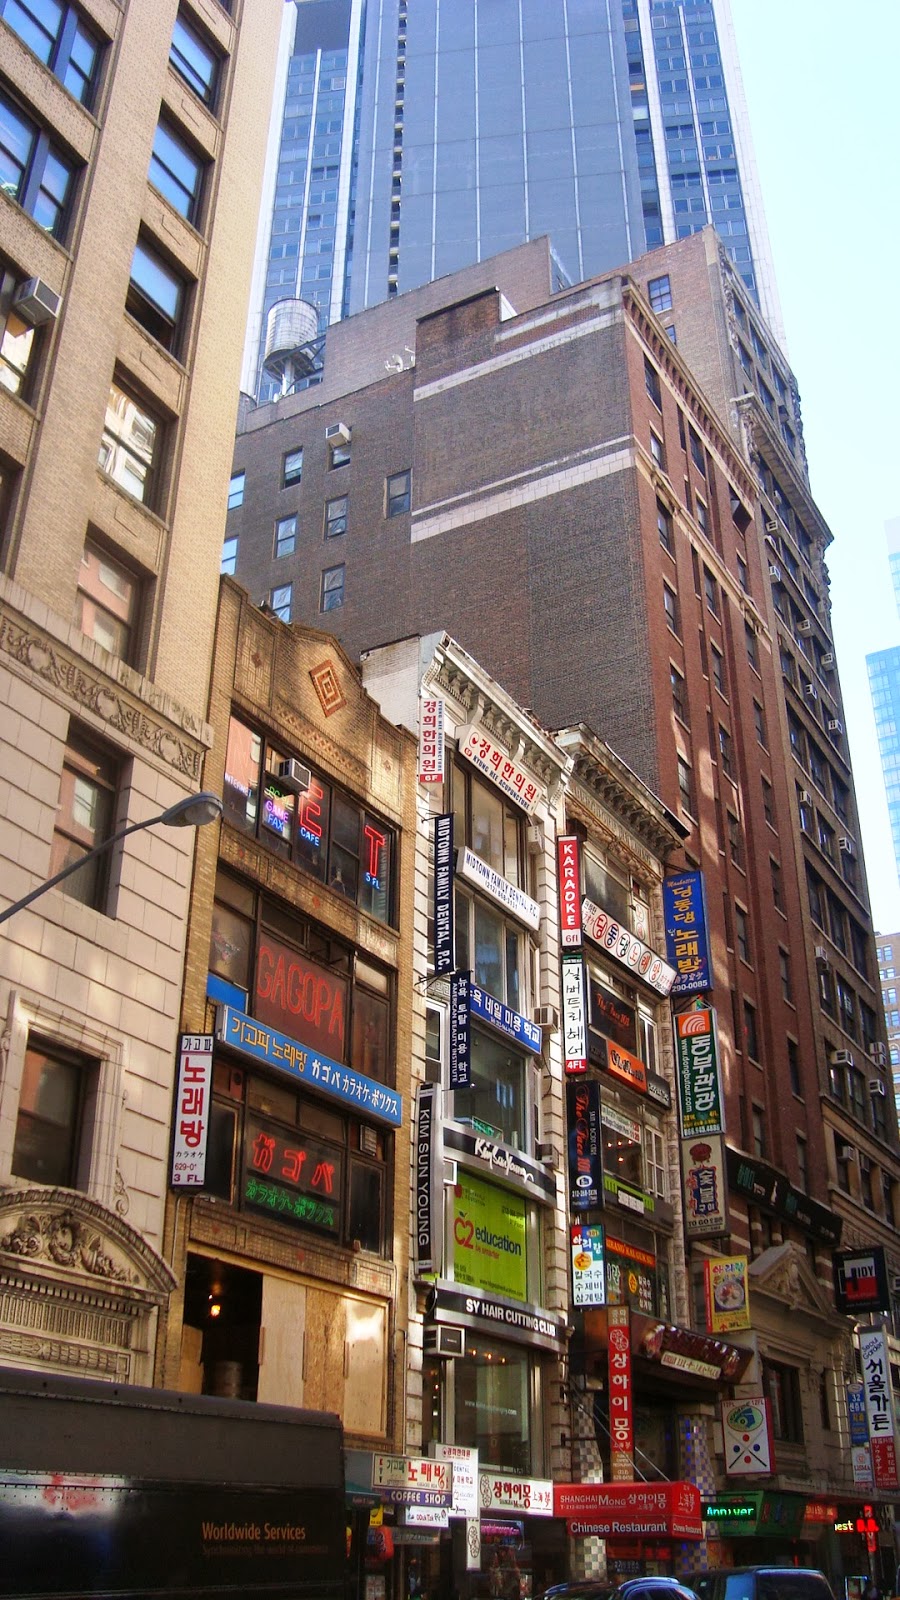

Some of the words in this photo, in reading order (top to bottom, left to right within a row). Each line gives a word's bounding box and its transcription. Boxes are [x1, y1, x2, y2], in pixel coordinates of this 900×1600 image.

[422, 701, 437, 772] 경희한의원
[424, 773, 438, 781] 6F
[480, 738, 538, 803] 경희한의원
[499, 780, 530, 810] ACUPUNCTURE
[266, 800, 289, 823] GAME
[268, 813, 284, 832] FAX
[300, 827, 319, 847] CAFE
[437, 818, 450, 864] MIDTOWN
[436, 865, 450, 901] FAMILY
[466, 852, 491, 881] MIDTOWN
[491, 872, 509, 897] FAMILY
[562, 844, 576, 926] KARAOKE
[436, 903, 450, 948] DENTAL,
[437, 950, 450, 970] P.C.
[674, 929, 702, 973] 노래방
[257, 945, 343, 1041] GAGOPA
[672, 980, 708, 993] 290-0085
[470, 988, 483, 1008] 욕
[485, 995, 502, 1021] 네일
[504, 1009, 522, 1033] 미용
[523, 1021, 540, 1044] 학교
[183, 1037, 212, 1051] 가고파
[457, 1031, 468, 1055] 미용
[457, 1061, 468, 1083] 학교
[567, 1061, 585, 1069] 4FL
[681, 1038, 692, 1113] www.dongbutour.com
[691, 1034, 715, 1111] 동부관광
[180, 1056, 206, 1148] 노래방
[575, 1085, 589, 1117] The
[418, 1108, 430, 1138] KIM
[575, 1117, 588, 1158] Face
[175, 1150, 205, 1159] カラオケ
[418, 1142, 429, 1178] SUN
[474, 1137, 494, 1170] Kim
[577, 1158, 591, 1174] 101
[173, 1173, 181, 1183] 3
[186, 1173, 204, 1184] FL.
[418, 1181, 429, 1246] YOUNG
[699, 1218, 709, 1226] GO
[454, 1214, 474, 1249] C2
[475, 1226, 522, 1257] education
[572, 1233, 603, 1254] 아리랑
[574, 1281, 603, 1292] 수제비
[466, 1298, 480, 1313] SY
[481, 1304, 504, 1321] HAIR
[505, 1309, 538, 1331] CUTTING
[539, 1318, 556, 1337] CLUB
[861, 1336, 879, 1352] Seoul
[862, 1341, 884, 1361] Garden
[611, 1352, 630, 1441] 상하이몽
[865, 1357, 891, 1431] 서울가든
[390, 1490, 421, 1502] COFFEE
[424, 1494, 446, 1505] SHOP
[493, 1481, 532, 1509] 상하이몽
[560, 1495, 598, 1503] SHANGHAI
[627, 1493, 668, 1510] 상하이몽
[202, 1522, 262, 1541] Worldwide
[264, 1523, 306, 1541] Services
[570, 1521, 610, 1533] Chinese
[612, 1520, 668, 1533] Restaurant
